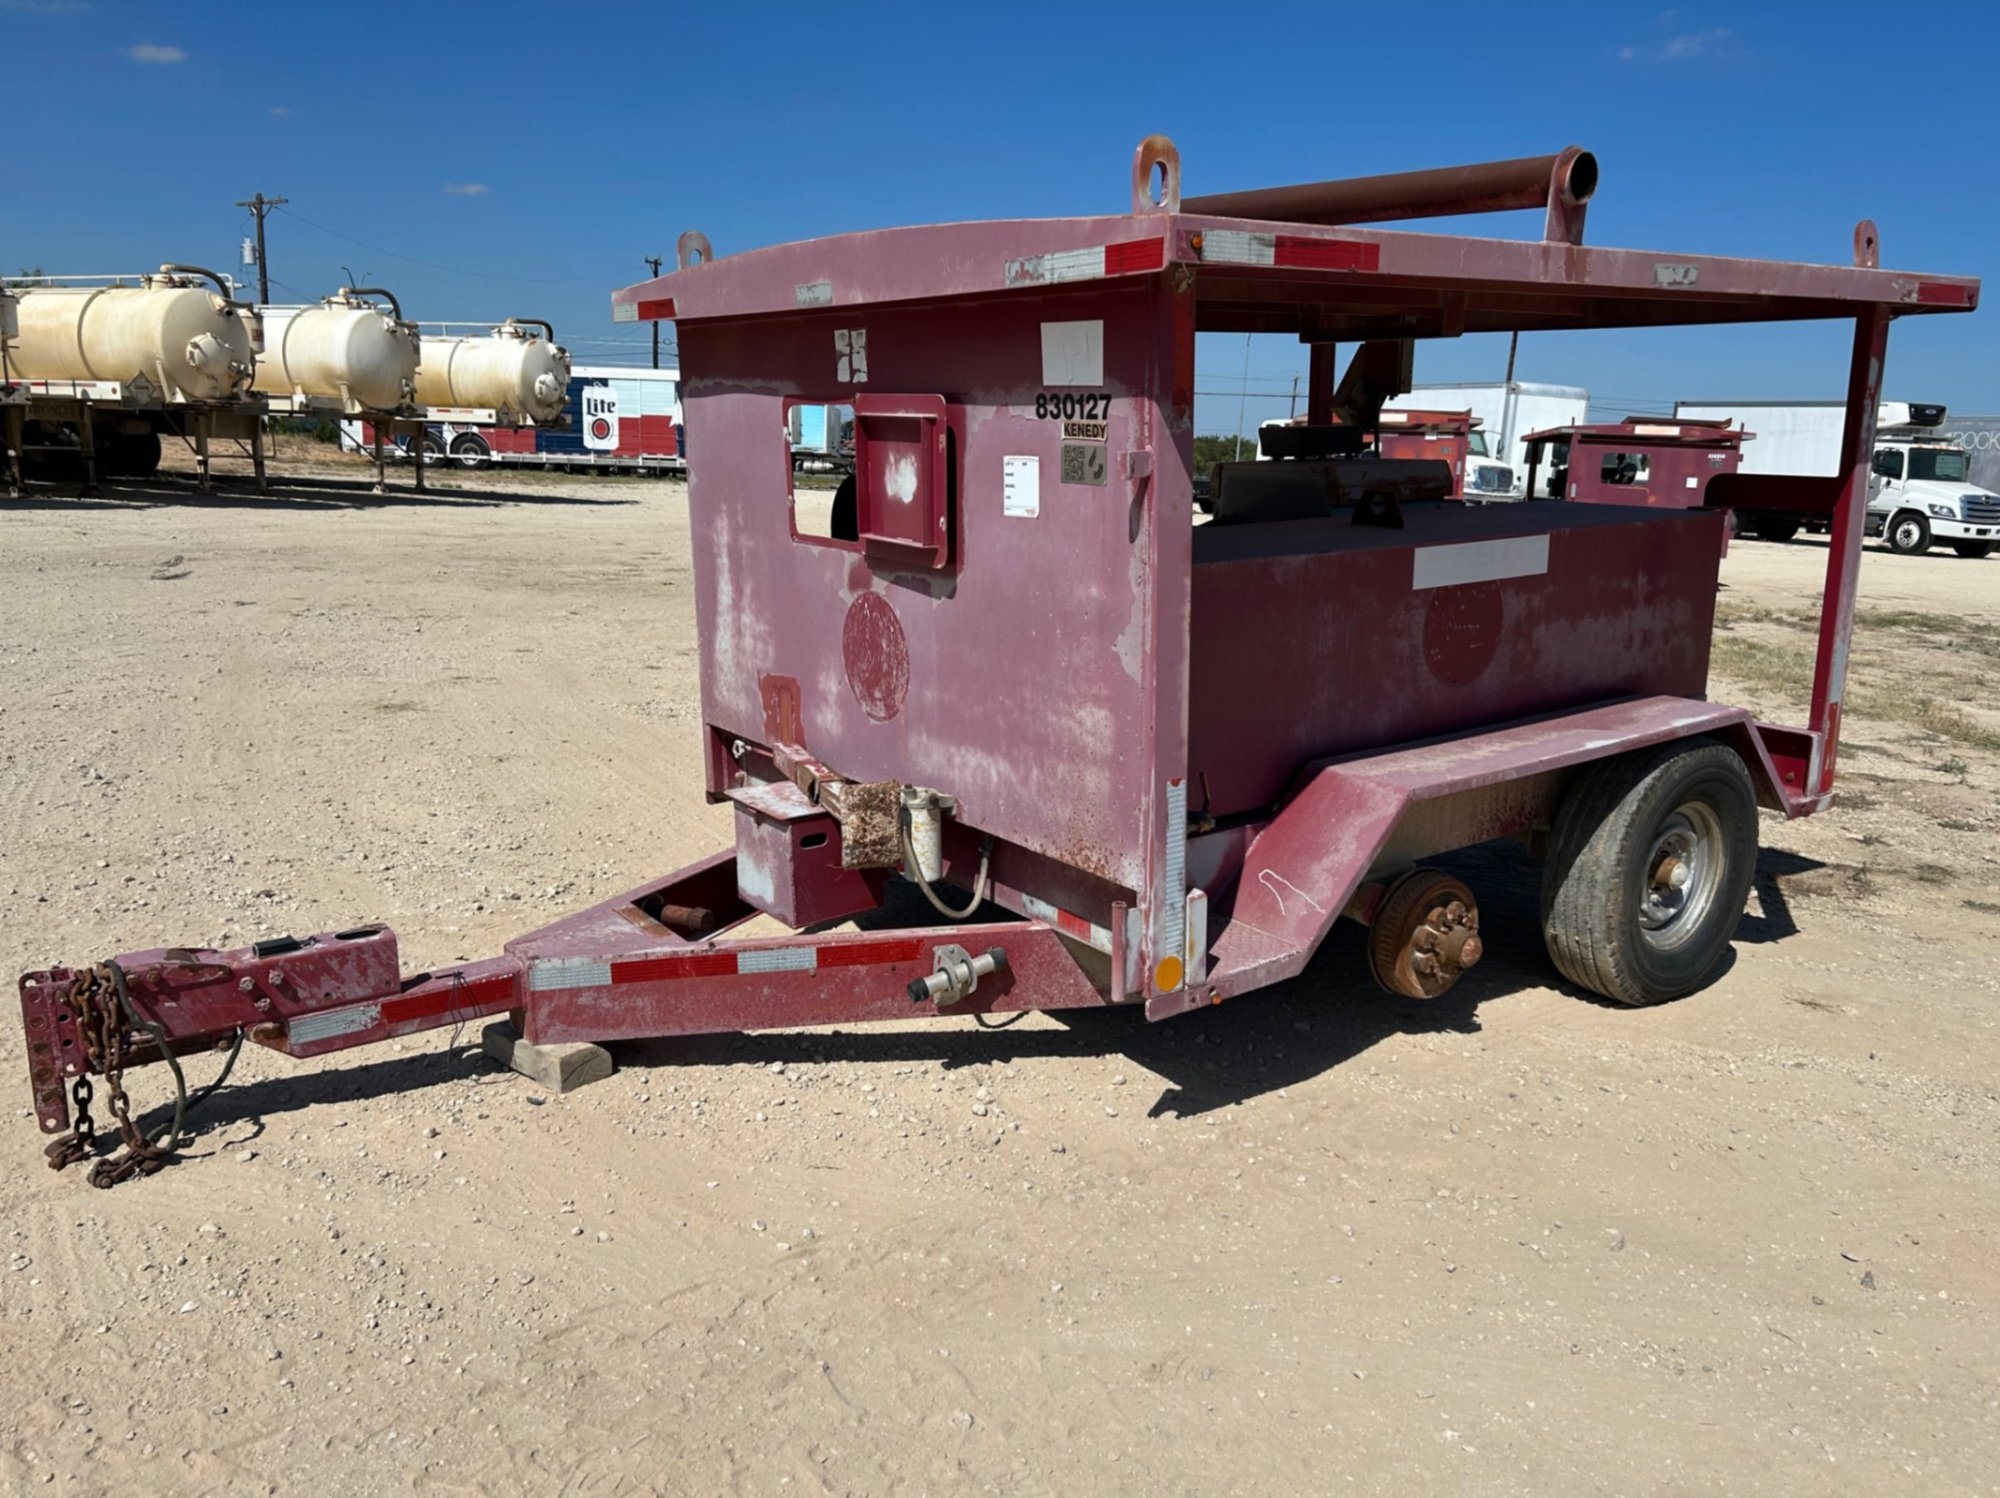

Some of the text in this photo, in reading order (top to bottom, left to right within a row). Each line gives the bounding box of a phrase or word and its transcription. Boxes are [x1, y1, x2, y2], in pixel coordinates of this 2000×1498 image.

[586, 397, 616, 417] Lite
[1035, 393, 1112, 420] 830127
[1063, 423, 1106, 439] KENEDY
